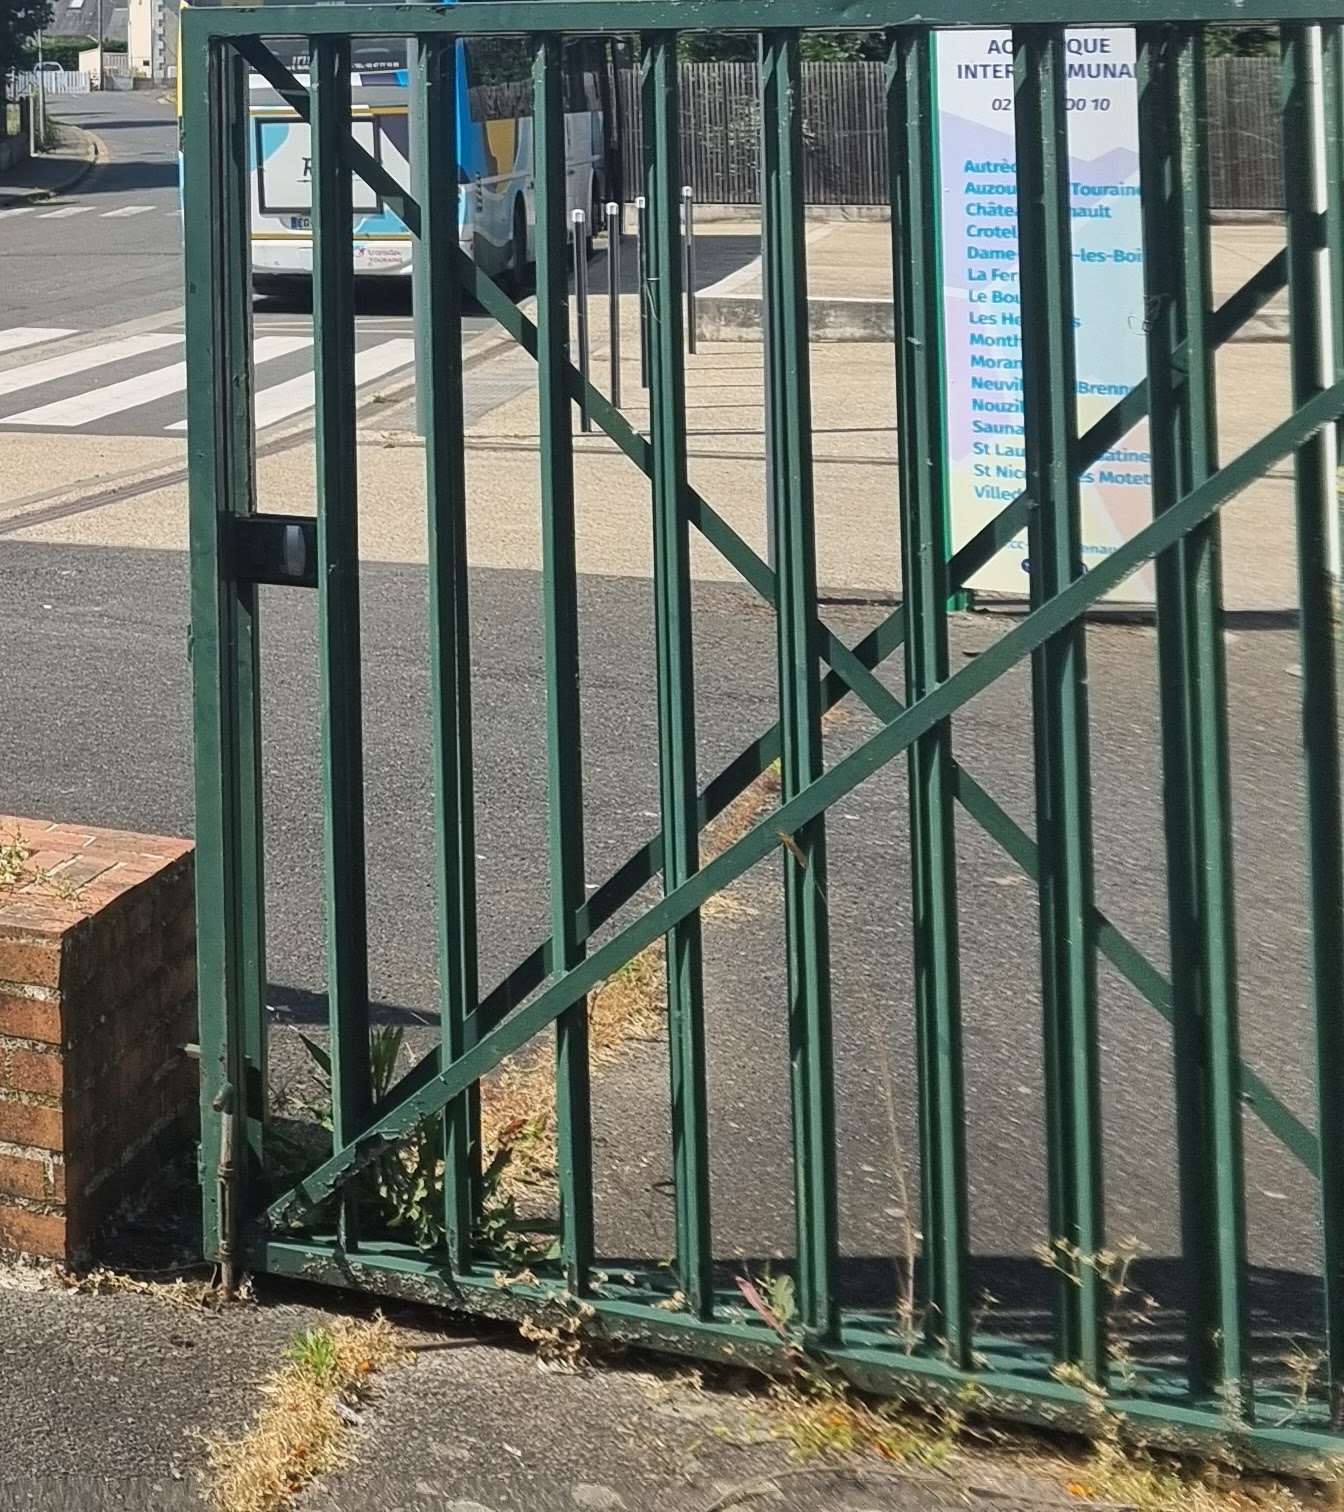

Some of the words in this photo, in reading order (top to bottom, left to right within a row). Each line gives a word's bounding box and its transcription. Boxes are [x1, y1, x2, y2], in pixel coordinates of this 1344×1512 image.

[1091, 98, 1111, 112] 10
[966, 224, 1018, 239] Crotel
[968, 267, 987, 282] La
[968, 289, 988, 303] Le
[969, 311, 997, 325] Les
[970, 354, 1023, 369] Moran
[972, 420, 1025, 435] Sauna
[973, 442, 991, 456] St
[974, 464, 992, 478] St
